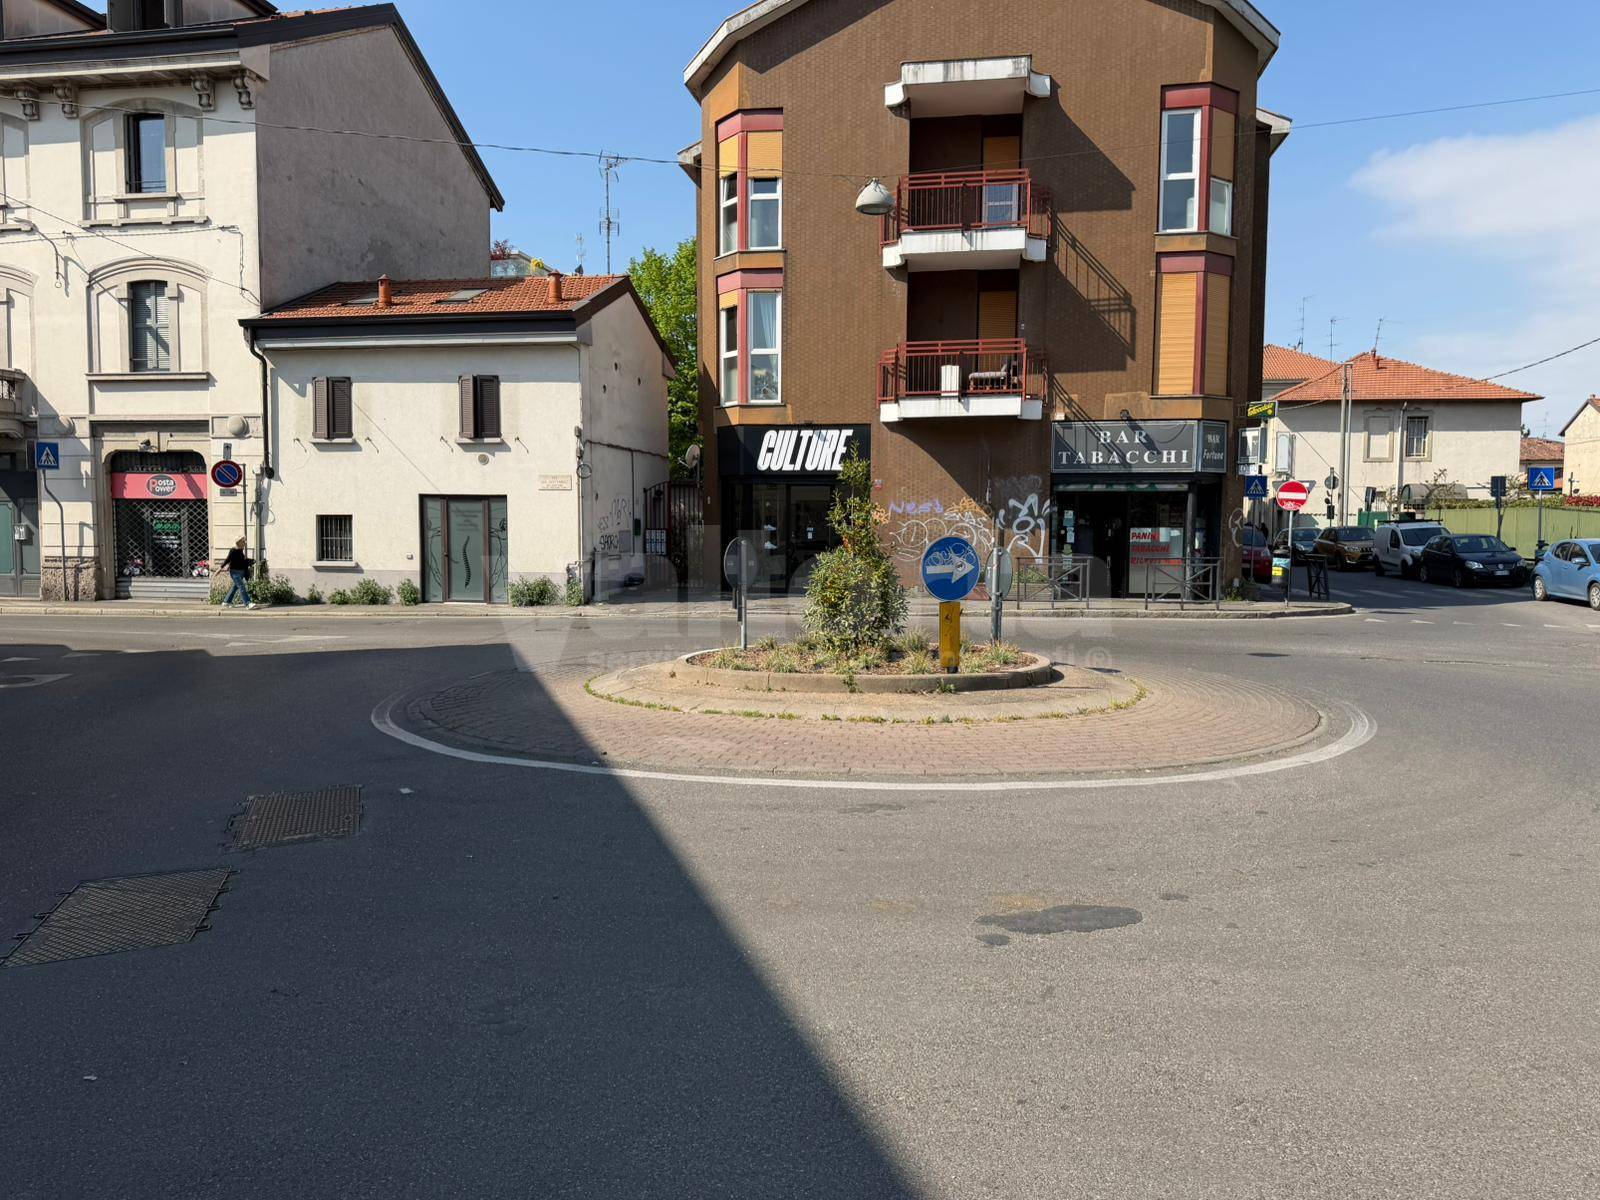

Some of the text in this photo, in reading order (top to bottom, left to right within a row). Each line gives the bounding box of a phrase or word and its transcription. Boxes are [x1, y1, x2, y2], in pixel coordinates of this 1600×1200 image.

[1097, 430, 1149, 444] BAR
[1206, 434, 1220, 444] BAR
[757, 429, 853, 471] CULTURE
[1058, 449, 1189, 465] TABACCHI
